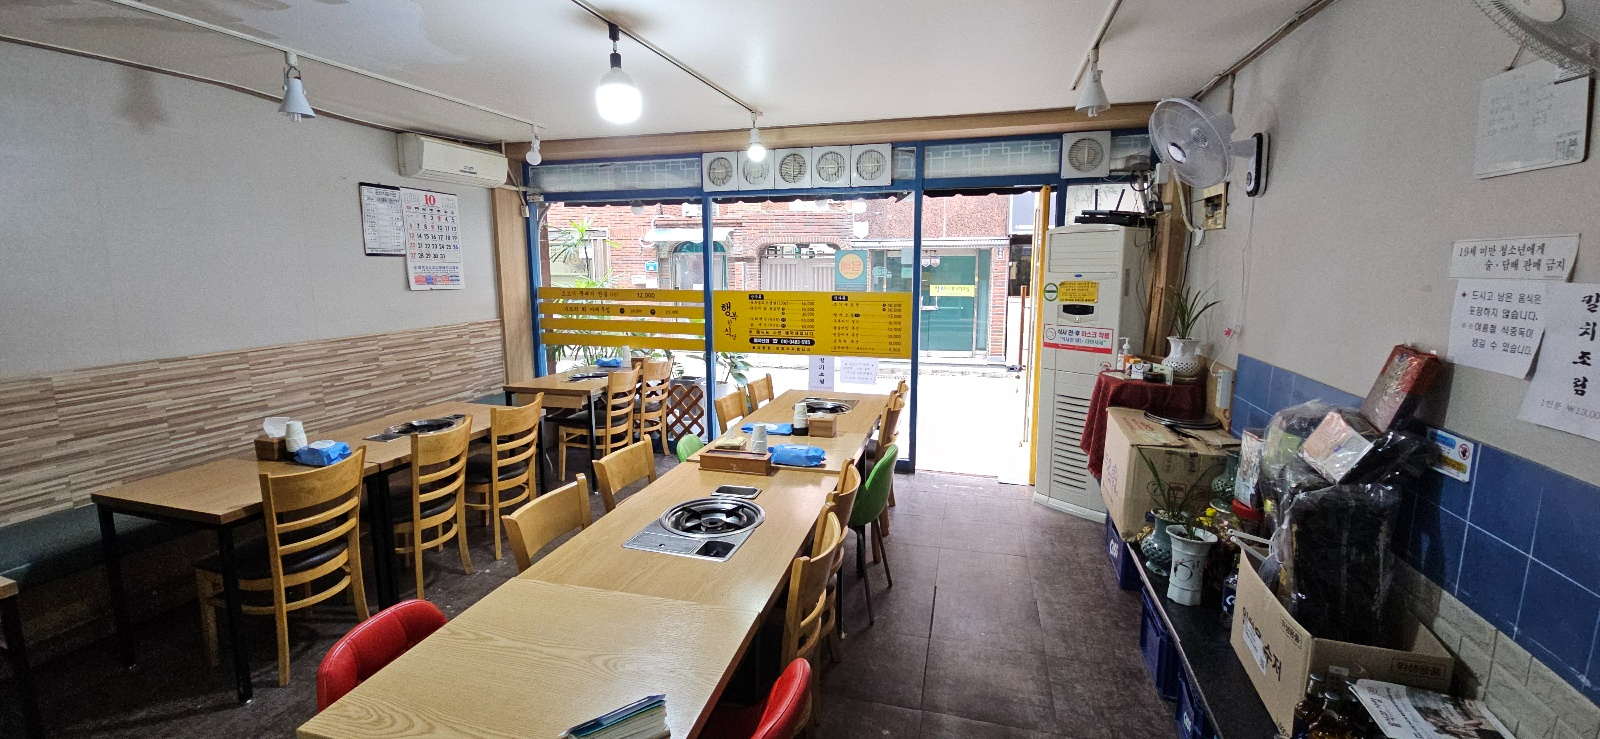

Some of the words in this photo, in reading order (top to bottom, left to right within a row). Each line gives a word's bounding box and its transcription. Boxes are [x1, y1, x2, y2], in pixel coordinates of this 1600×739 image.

[424, 195, 436, 205] 10
[1460, 246, 1476, 257] 19세
[1480, 245, 1496, 257] 미만
[1499, 243, 1545, 257] 청소년에게
[1523, 258, 1541, 271] 판매
[1546, 258, 1565, 271] 금지
[1472, 291, 1493, 300] 드시고
[1498, 292, 1512, 302] 남은
[1519, 293, 1541, 304] 음식은
[1470, 306, 1498, 317] 포장하지
[1502, 326, 1534, 338] 식중독이
[1472, 338, 1485, 348] 생길
[1491, 341, 1497, 350] 수
